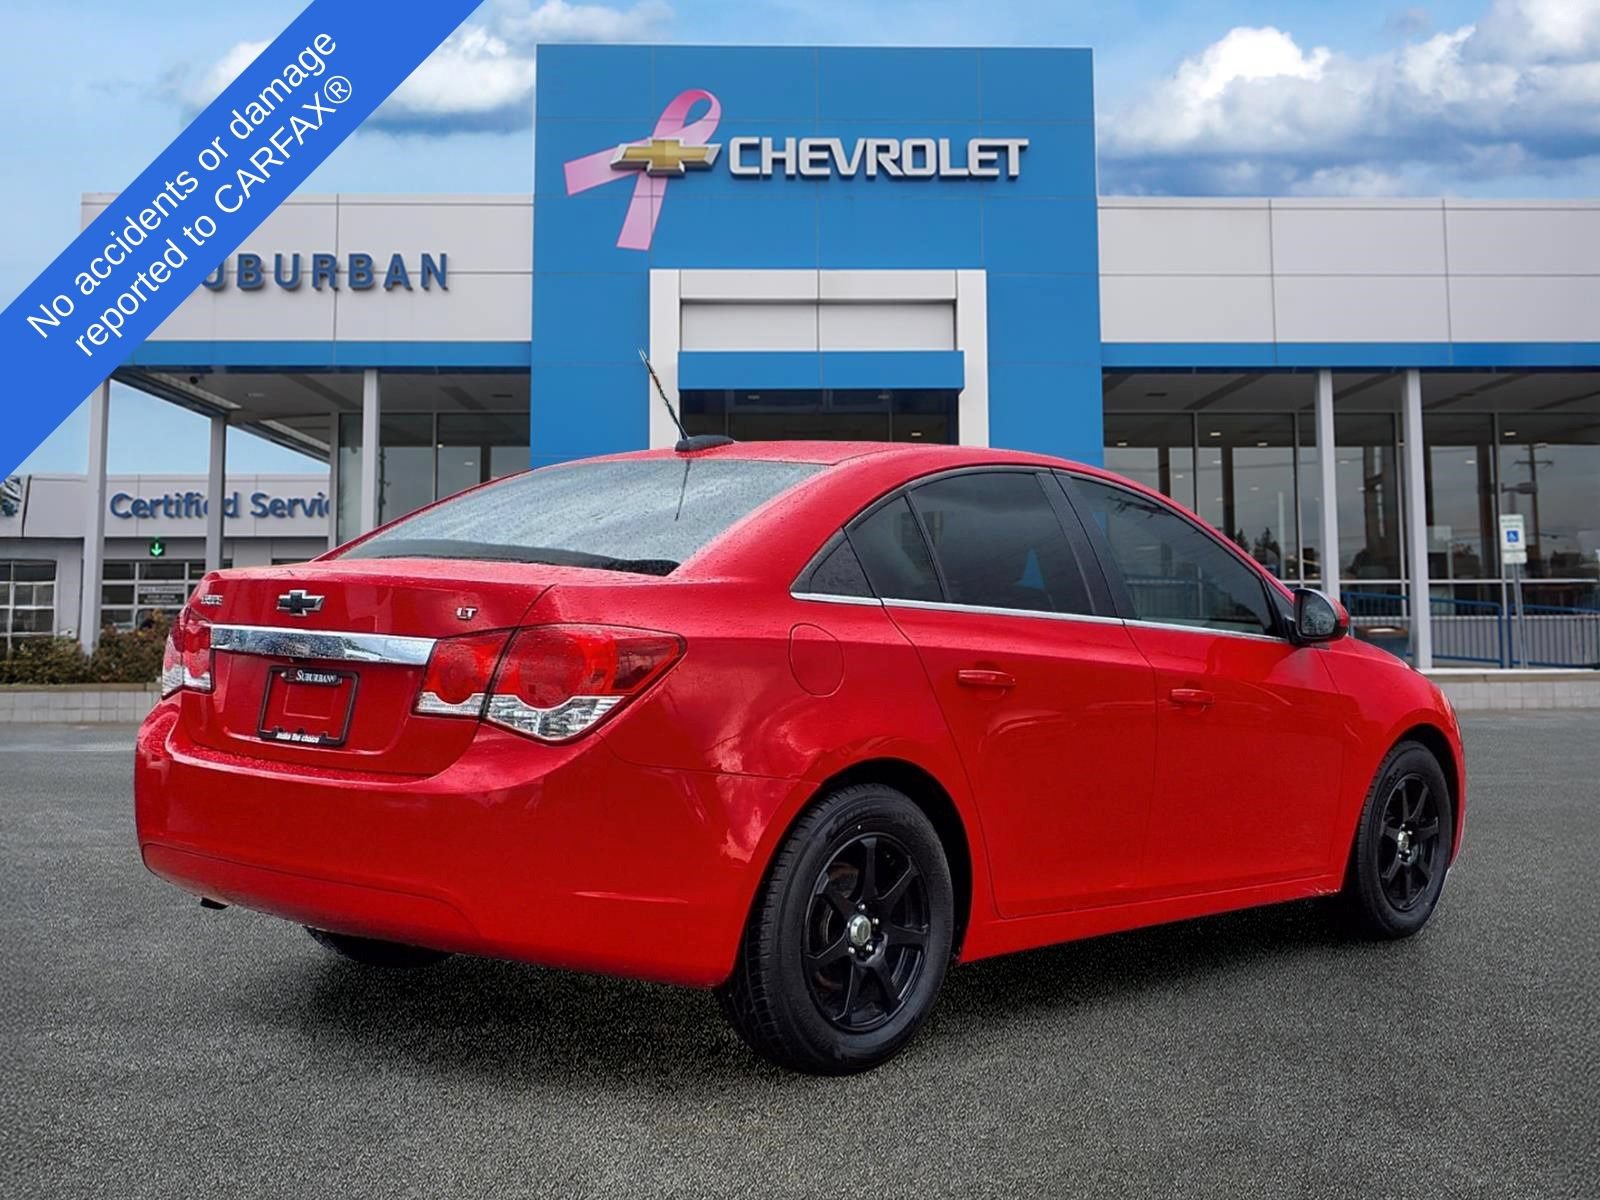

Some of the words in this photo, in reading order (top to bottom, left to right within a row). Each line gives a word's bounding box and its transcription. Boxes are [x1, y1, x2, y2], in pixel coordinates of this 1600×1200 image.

[729, 137, 1029, 178] CHEVROLET
[201, 253, 449, 290] UBURBAN
[110, 491, 240, 518] Certifid
[457, 607, 477, 619] LT
